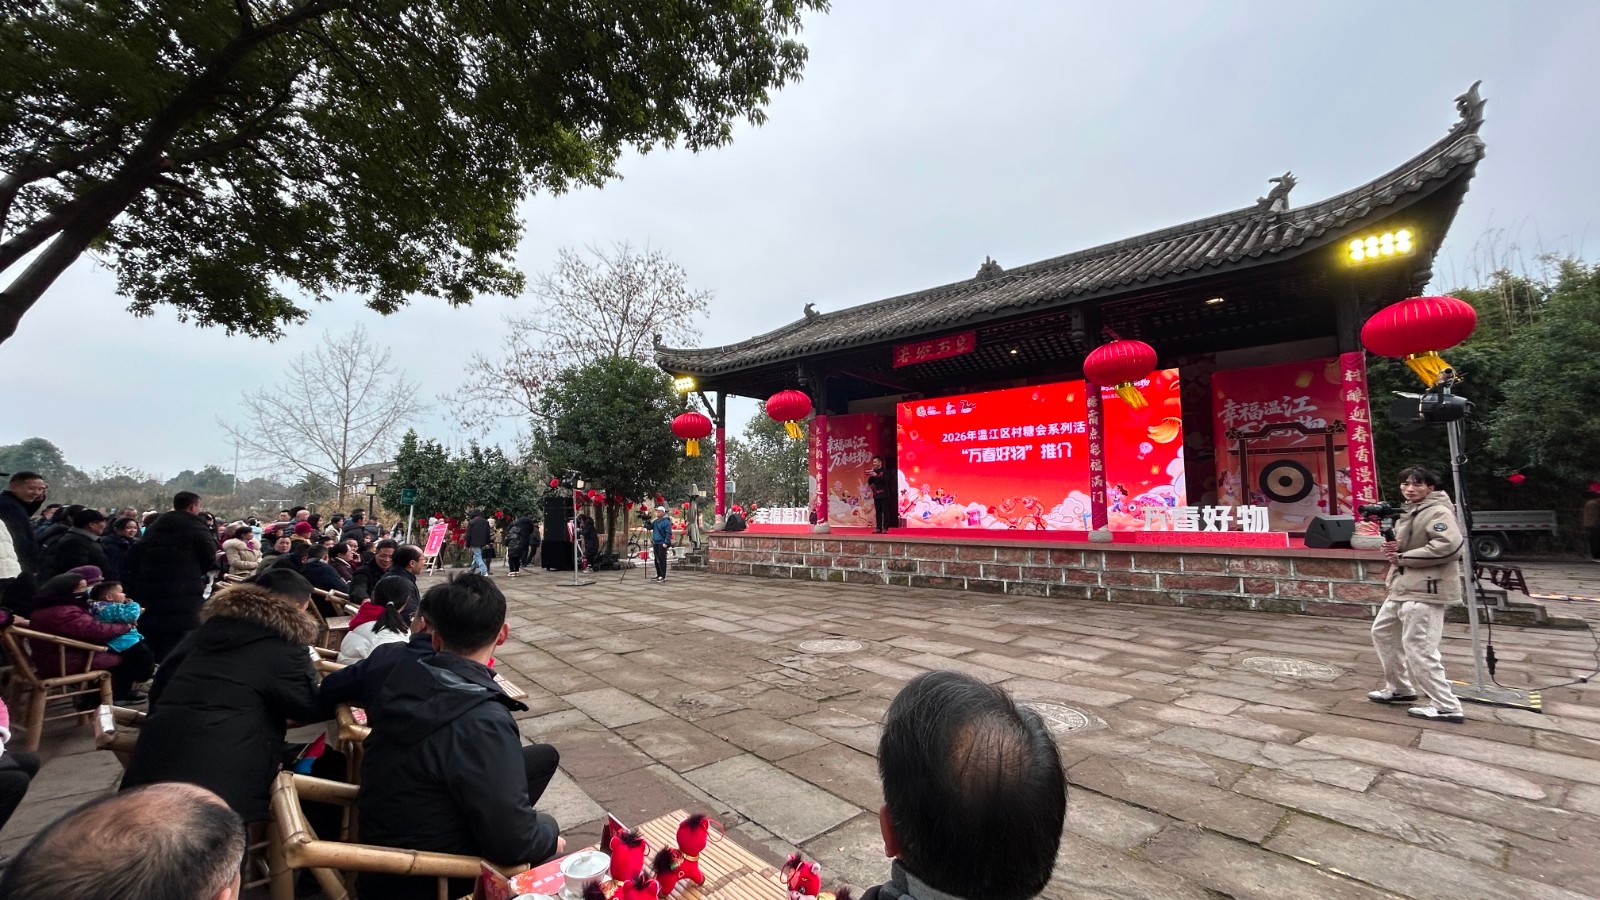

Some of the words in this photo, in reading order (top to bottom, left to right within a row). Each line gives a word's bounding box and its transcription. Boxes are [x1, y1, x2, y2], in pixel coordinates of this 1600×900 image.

[1217, 395, 1318, 428] 幸福温江
[941, 420, 1087, 443] 2026年温江区村糖会系列活
[1345, 368, 1377, 504] 村酿迎春香漫道
[1139, 504, 1270, 532] 万春好物
